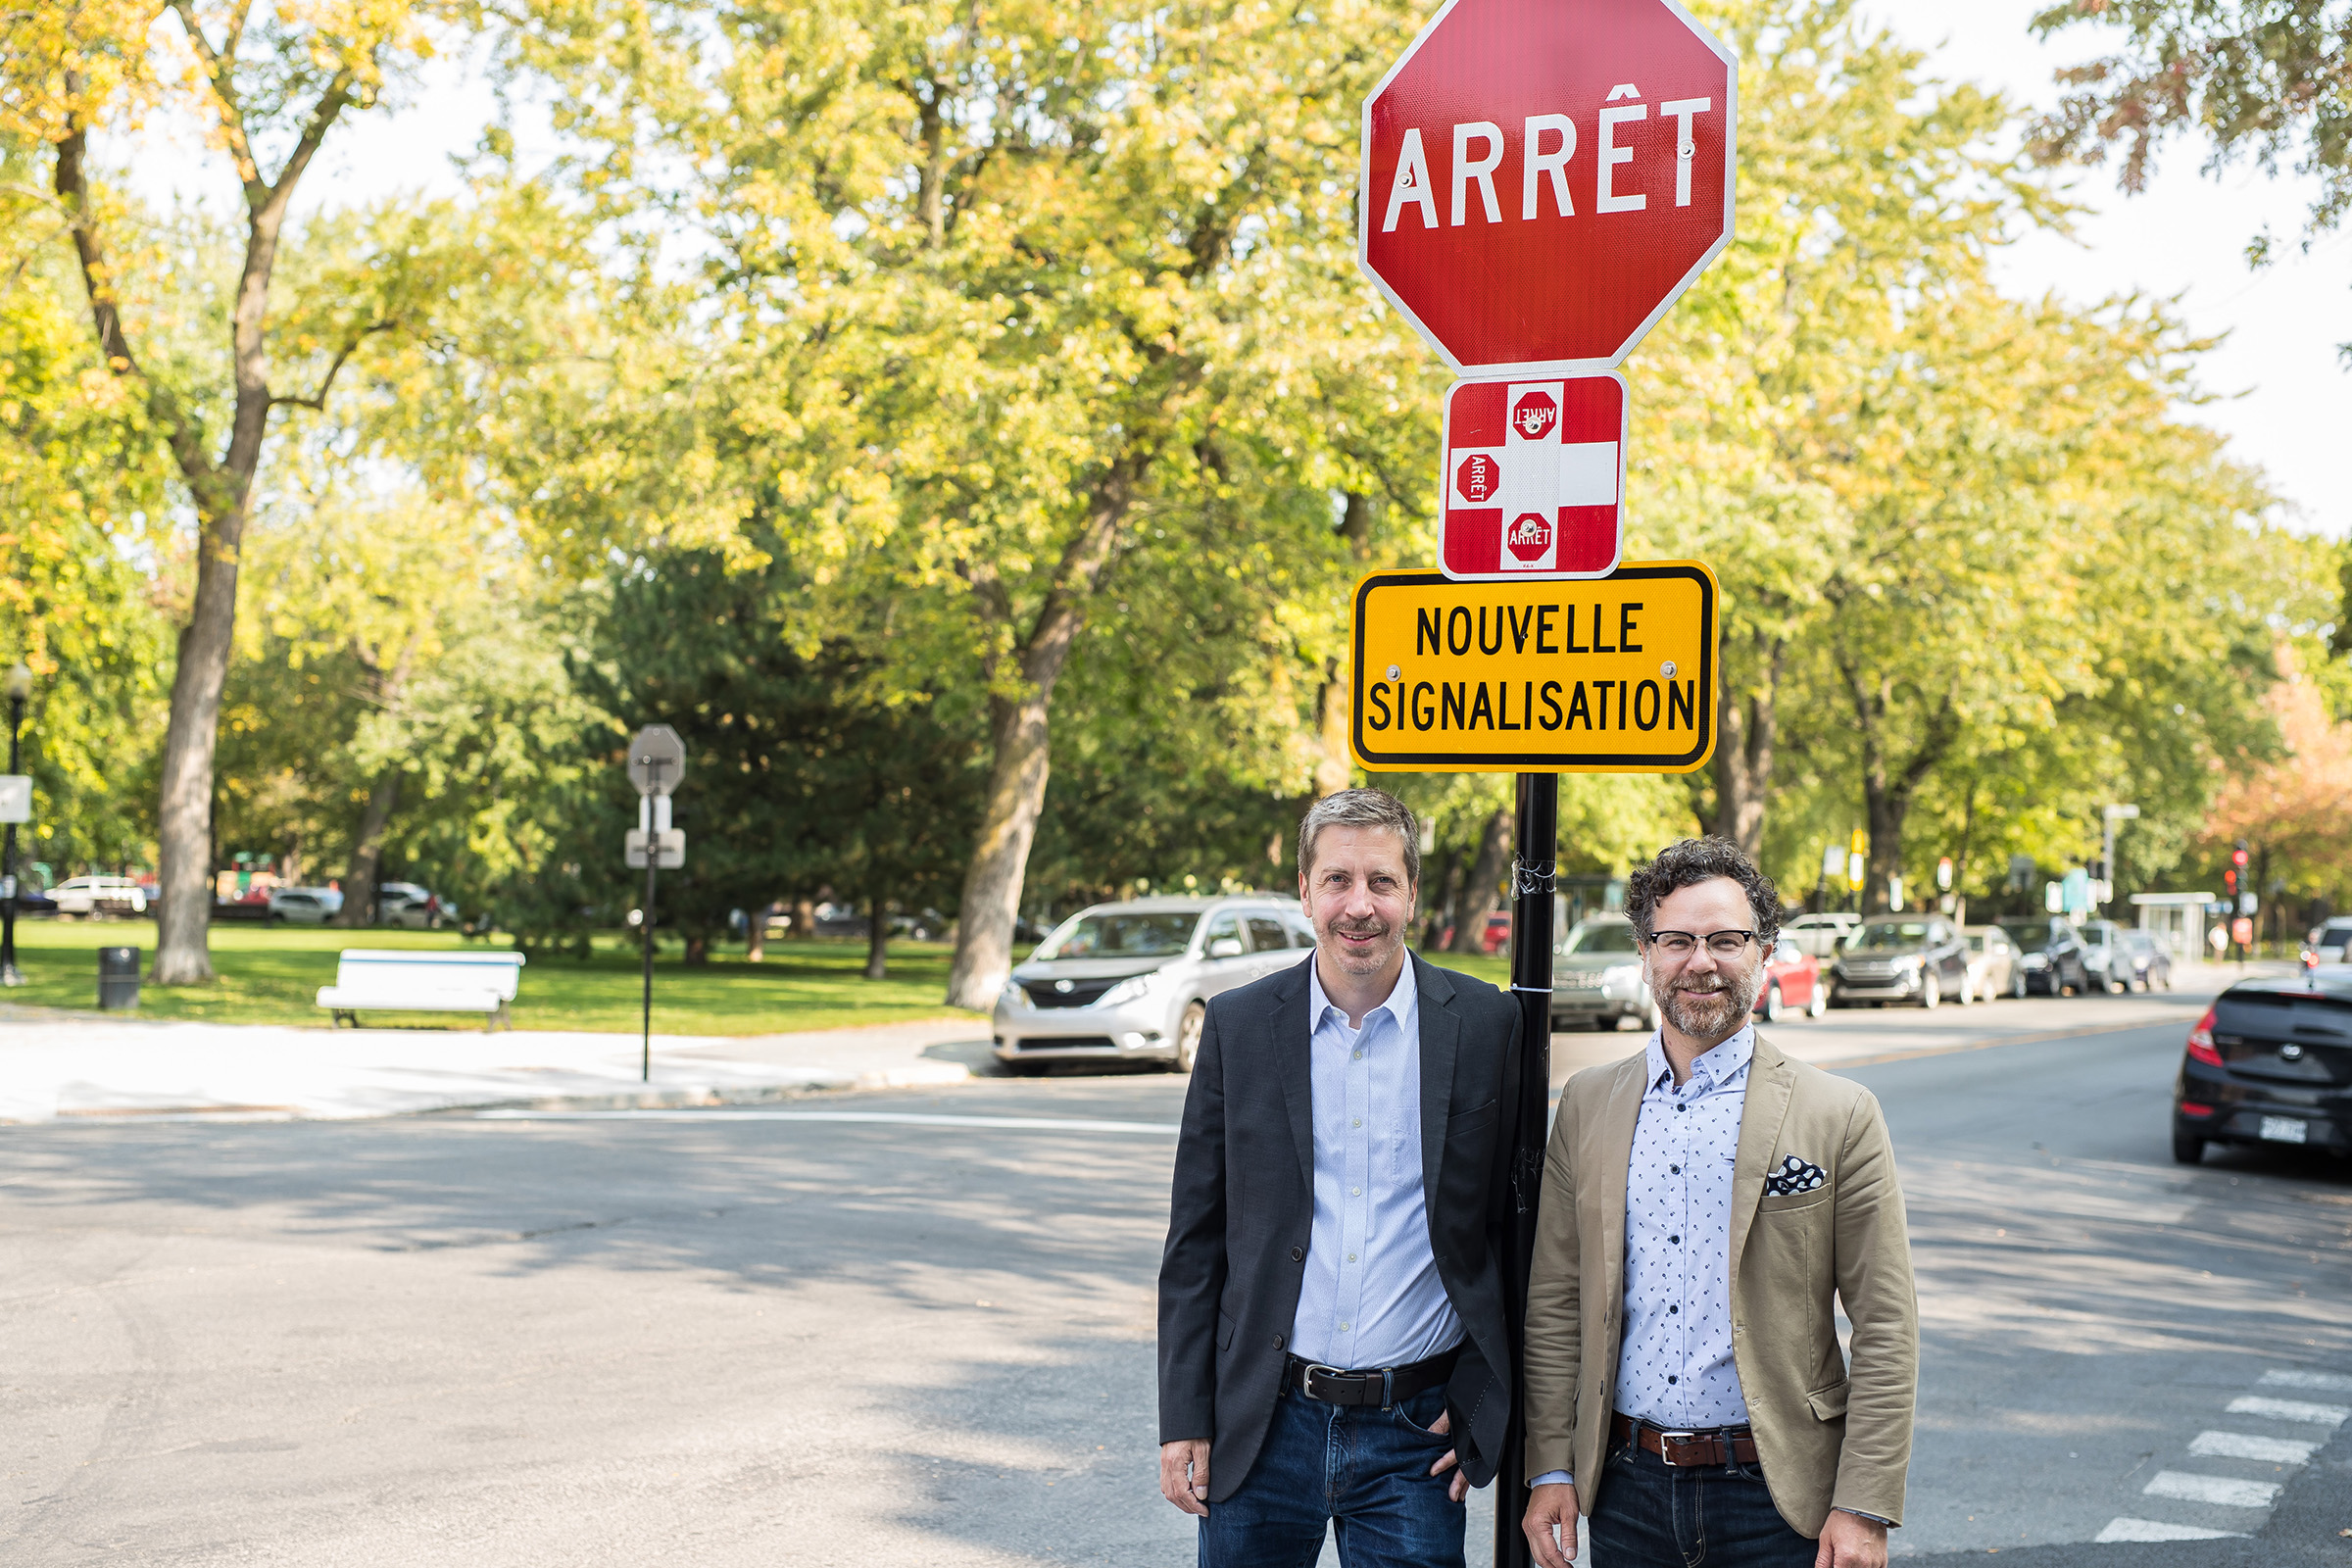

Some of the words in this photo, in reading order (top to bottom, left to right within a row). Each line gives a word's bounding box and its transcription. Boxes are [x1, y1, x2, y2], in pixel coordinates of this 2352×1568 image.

[1382, 83, 1711, 232] ARRÊT
[1470, 456, 1487, 500] ARRÊT
[1417, 604, 1643, 656] NOUVELLE
[1368, 679, 1694, 731] SIGNALISATION
